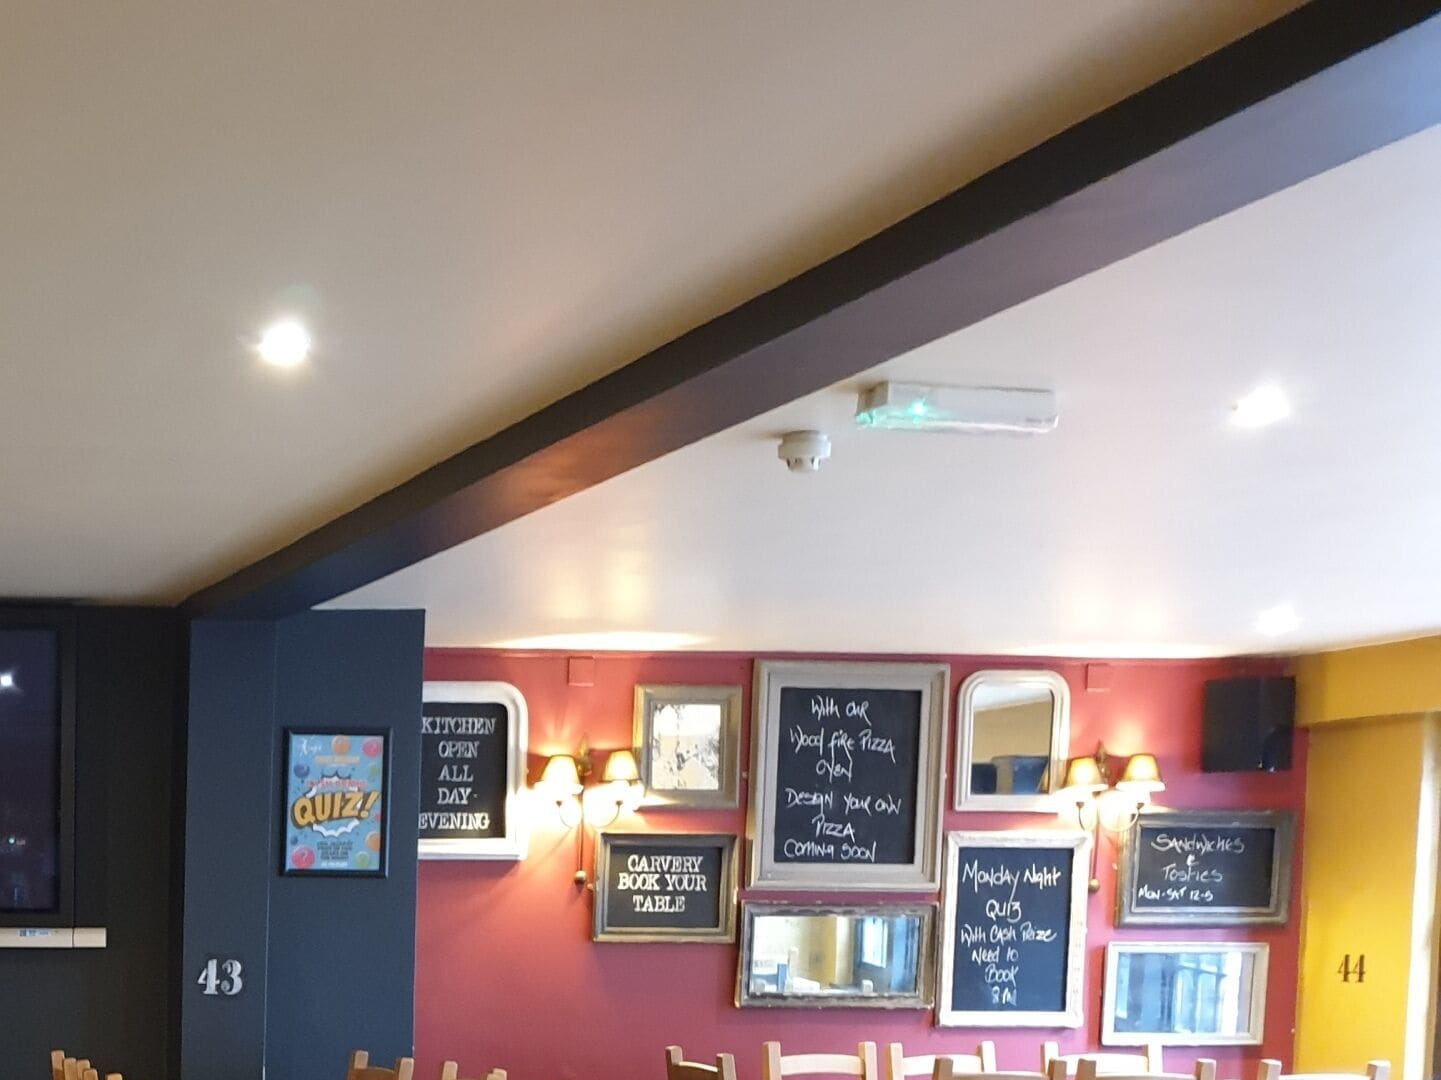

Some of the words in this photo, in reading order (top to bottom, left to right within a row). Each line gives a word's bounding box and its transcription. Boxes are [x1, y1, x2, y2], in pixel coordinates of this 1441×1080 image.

[421, 717, 496, 734] KITCHEN
[438, 741, 479, 758] OPEN
[438, 765, 473, 782] ALL
[293, 791, 380, 829] QUIZ!
[419, 812, 490, 830] EVENING
[627, 854, 703, 873] CARVERY
[617, 872, 660, 891] BOOK
[664, 873, 707, 892] YOUR
[632, 894, 685, 912] TABLE
[197, 958, 243, 996] 43
[1337, 954, 1366, 983] 44
